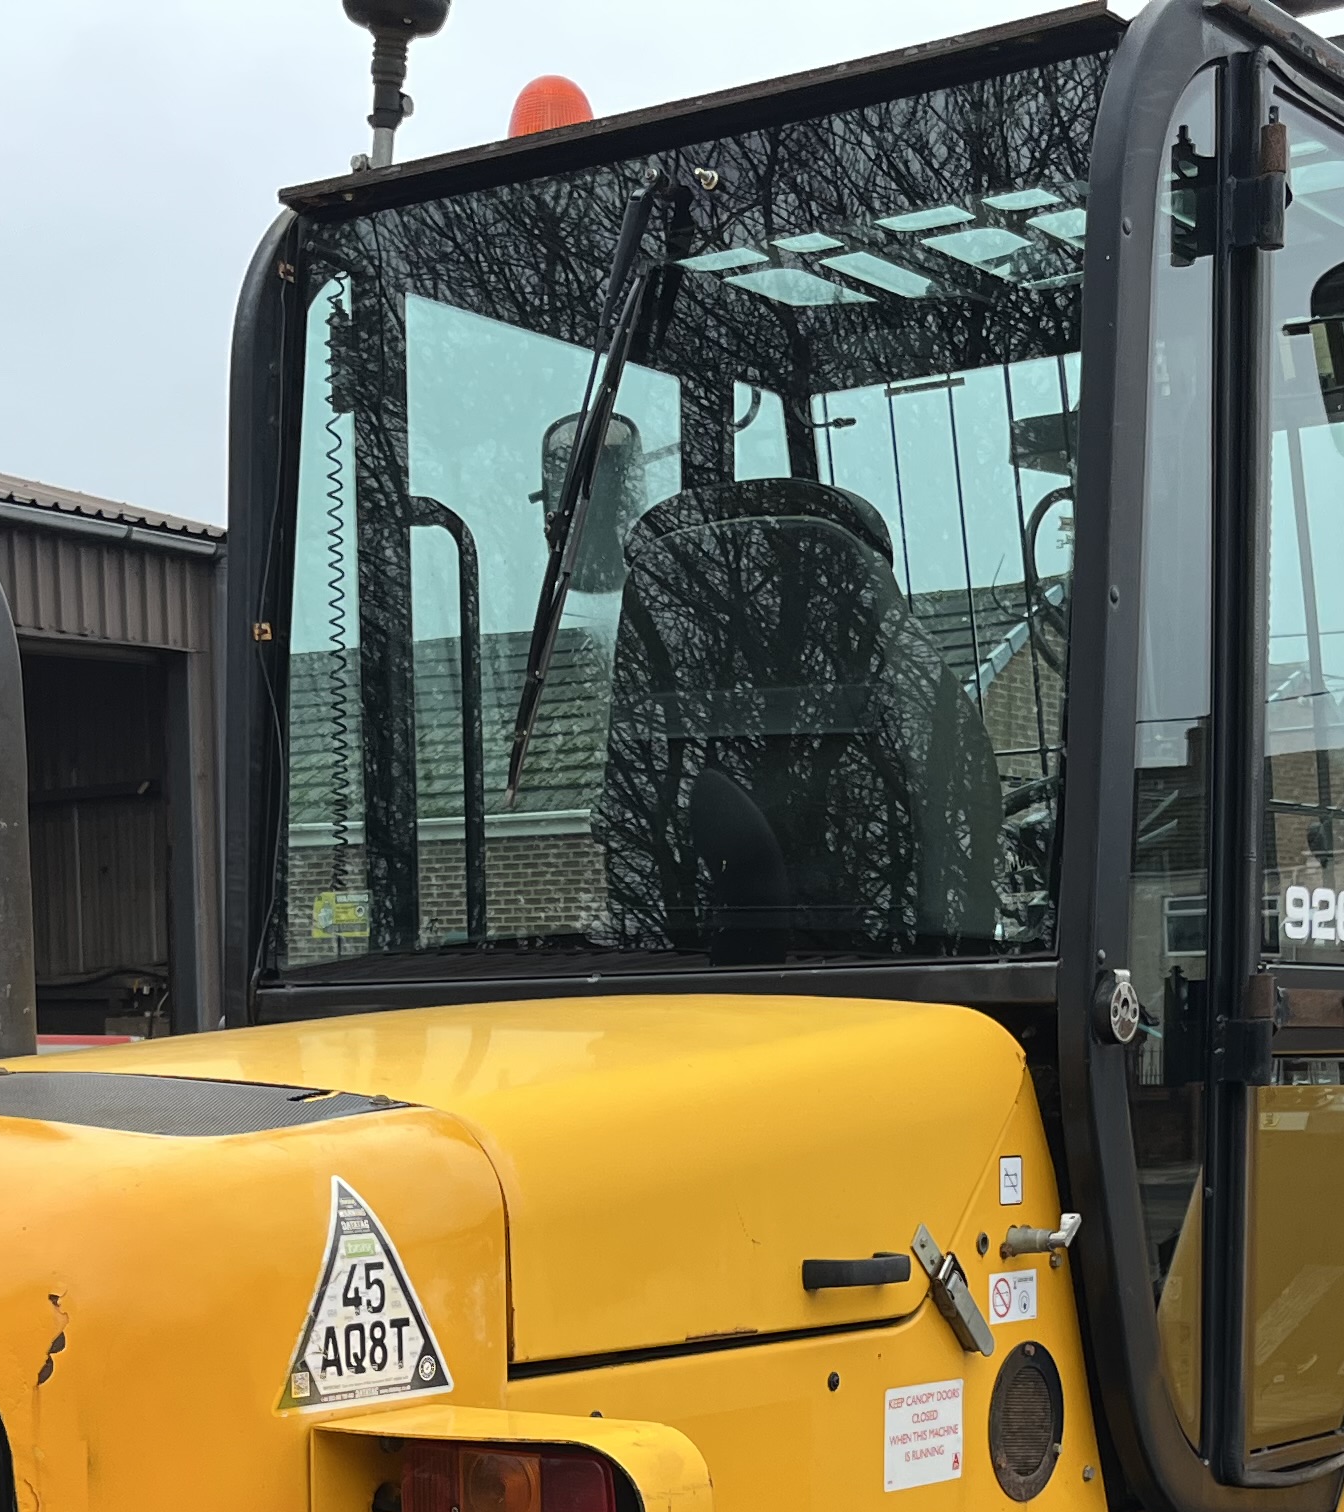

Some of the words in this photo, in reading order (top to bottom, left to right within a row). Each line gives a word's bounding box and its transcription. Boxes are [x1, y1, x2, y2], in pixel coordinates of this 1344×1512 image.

[342, 1261, 386, 1316] 45
[319, 1316, 411, 1380] AQ8T
[888, 1398, 905, 1410] KEEP
[906, 1392, 935, 1407] CANOPY
[937, 1388, 960, 1401] DOORS
[912, 1410, 938, 1424] CLOSED
[889, 1433, 912, 1446] WHEN
[913, 1430, 927, 1441] THIS
[929, 1424, 959, 1438] MACHINE
[905, 1451, 910, 1462] IS
[912, 1445, 944, 1460] RUNNING
